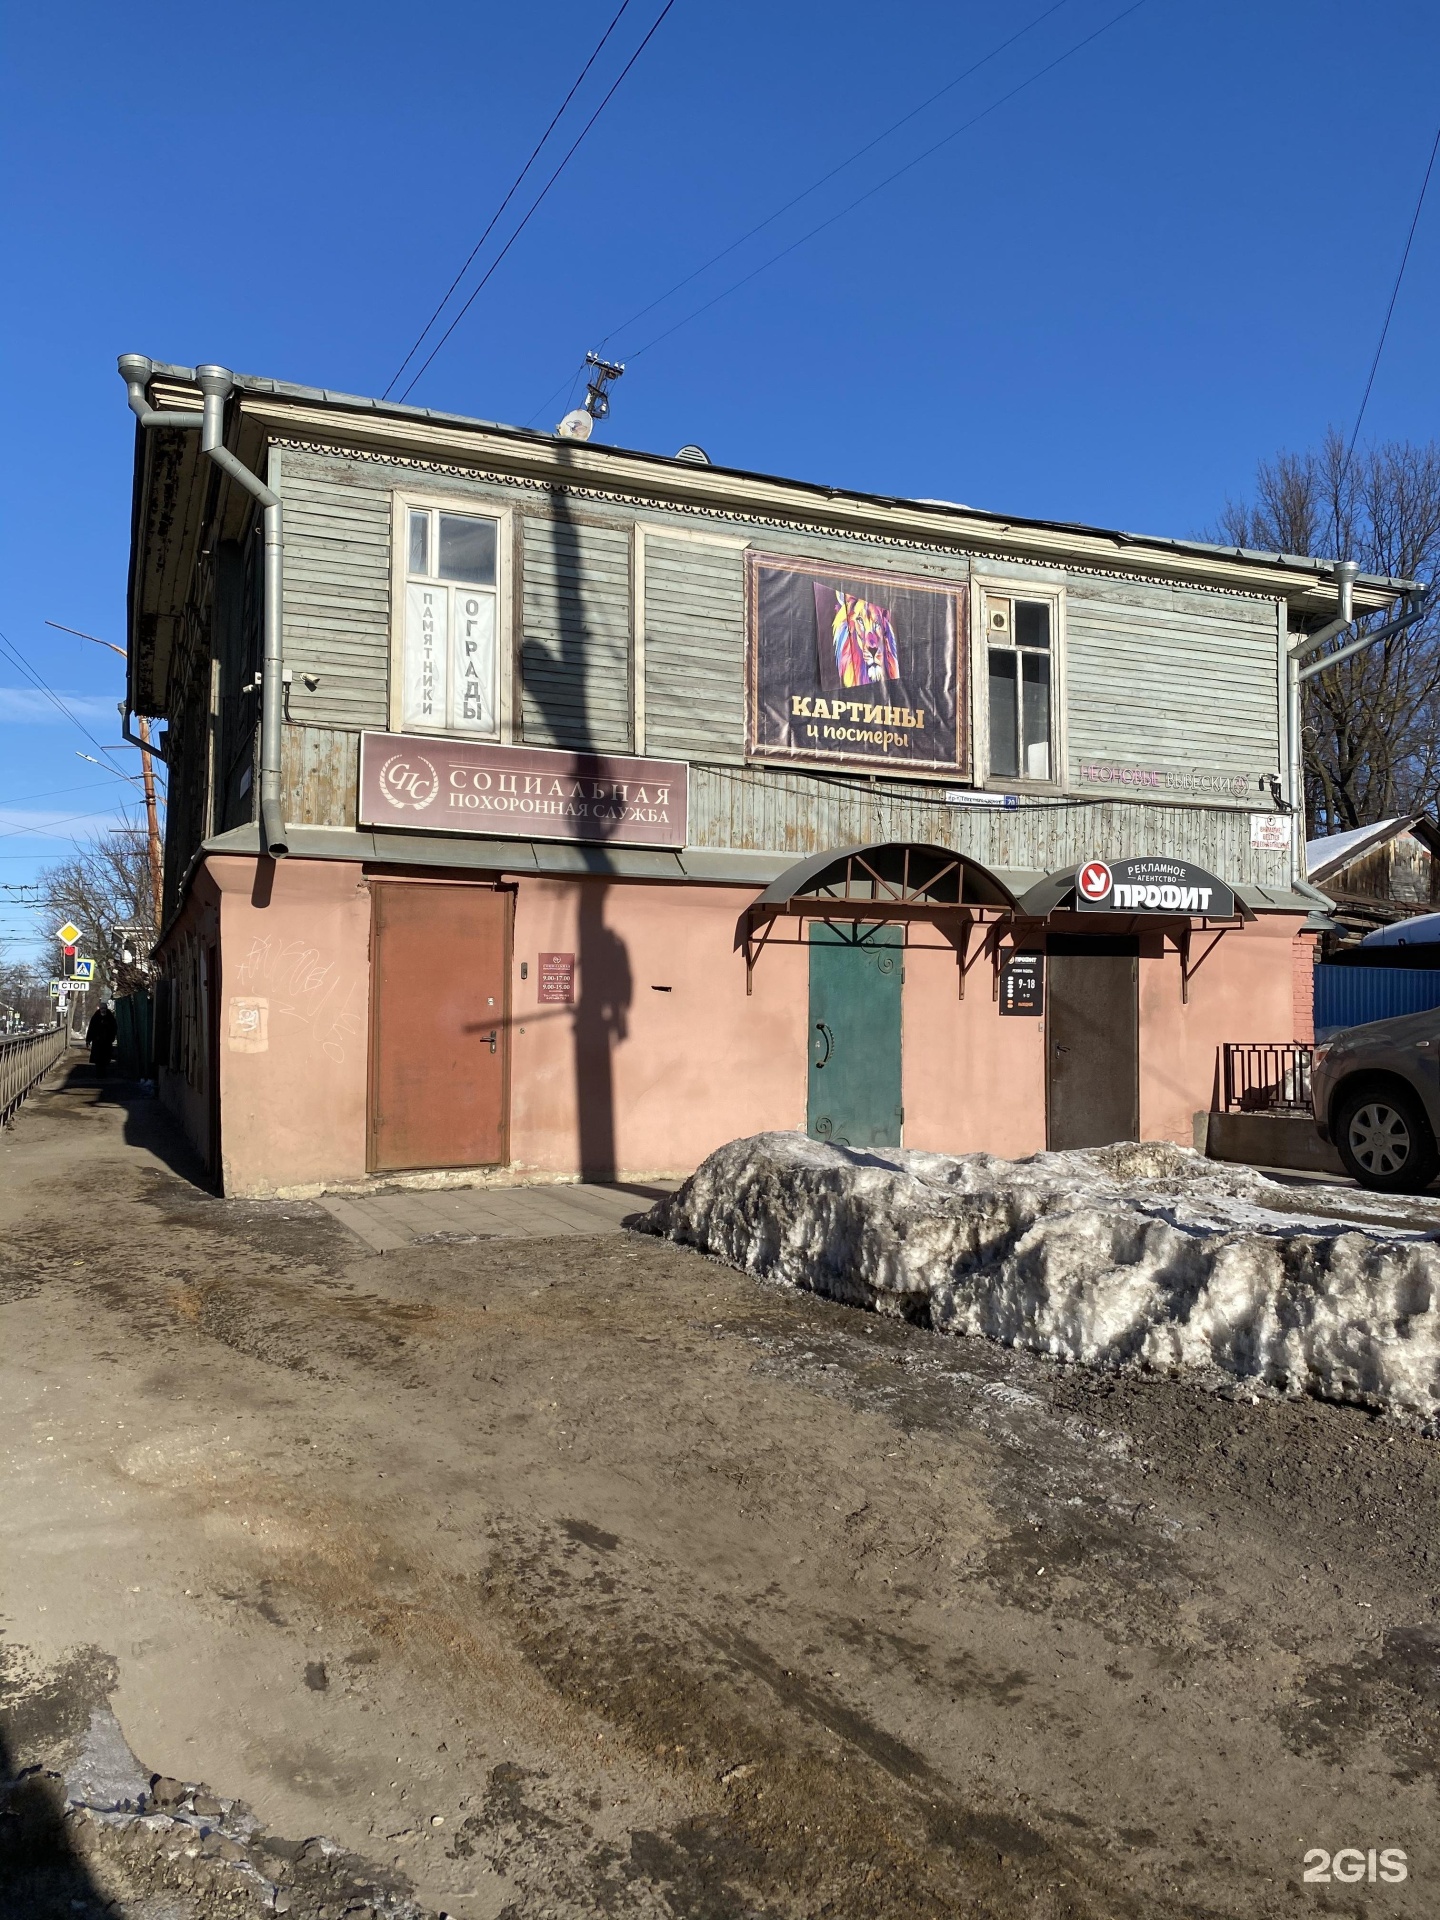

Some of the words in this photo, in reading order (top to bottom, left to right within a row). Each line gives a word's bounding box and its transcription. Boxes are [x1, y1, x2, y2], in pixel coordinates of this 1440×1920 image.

[422, 592, 434, 715] ПАМЯТНИКИ
[463, 599, 482, 721] ОГРАДЫ
[791, 695, 925, 729] КАРТИНЫ
[806, 724, 819, 738] и
[823, 725, 909, 752] постеры
[388, 763, 430, 799] СПС
[449, 770, 670, 805] СОЦИАЛЬНАЯ
[1080, 765, 1161, 787] НЕОНОВЫЕ
[1165, 771, 1230, 791] ВЫВЕСКИ
[449, 793, 588, 817] ПОХОРОННАЯ
[592, 803, 670, 824] СЛУЖБА
[1127, 863, 1187, 877] РЕКЛАМНОЕ
[1137, 875, 1176, 883] АГЕНТСТВО
[1113, 884, 1212, 910] ПРОФИТ
[61, 982, 86, 990] СТОП
[1018, 979, 1035, 988] 9-18
